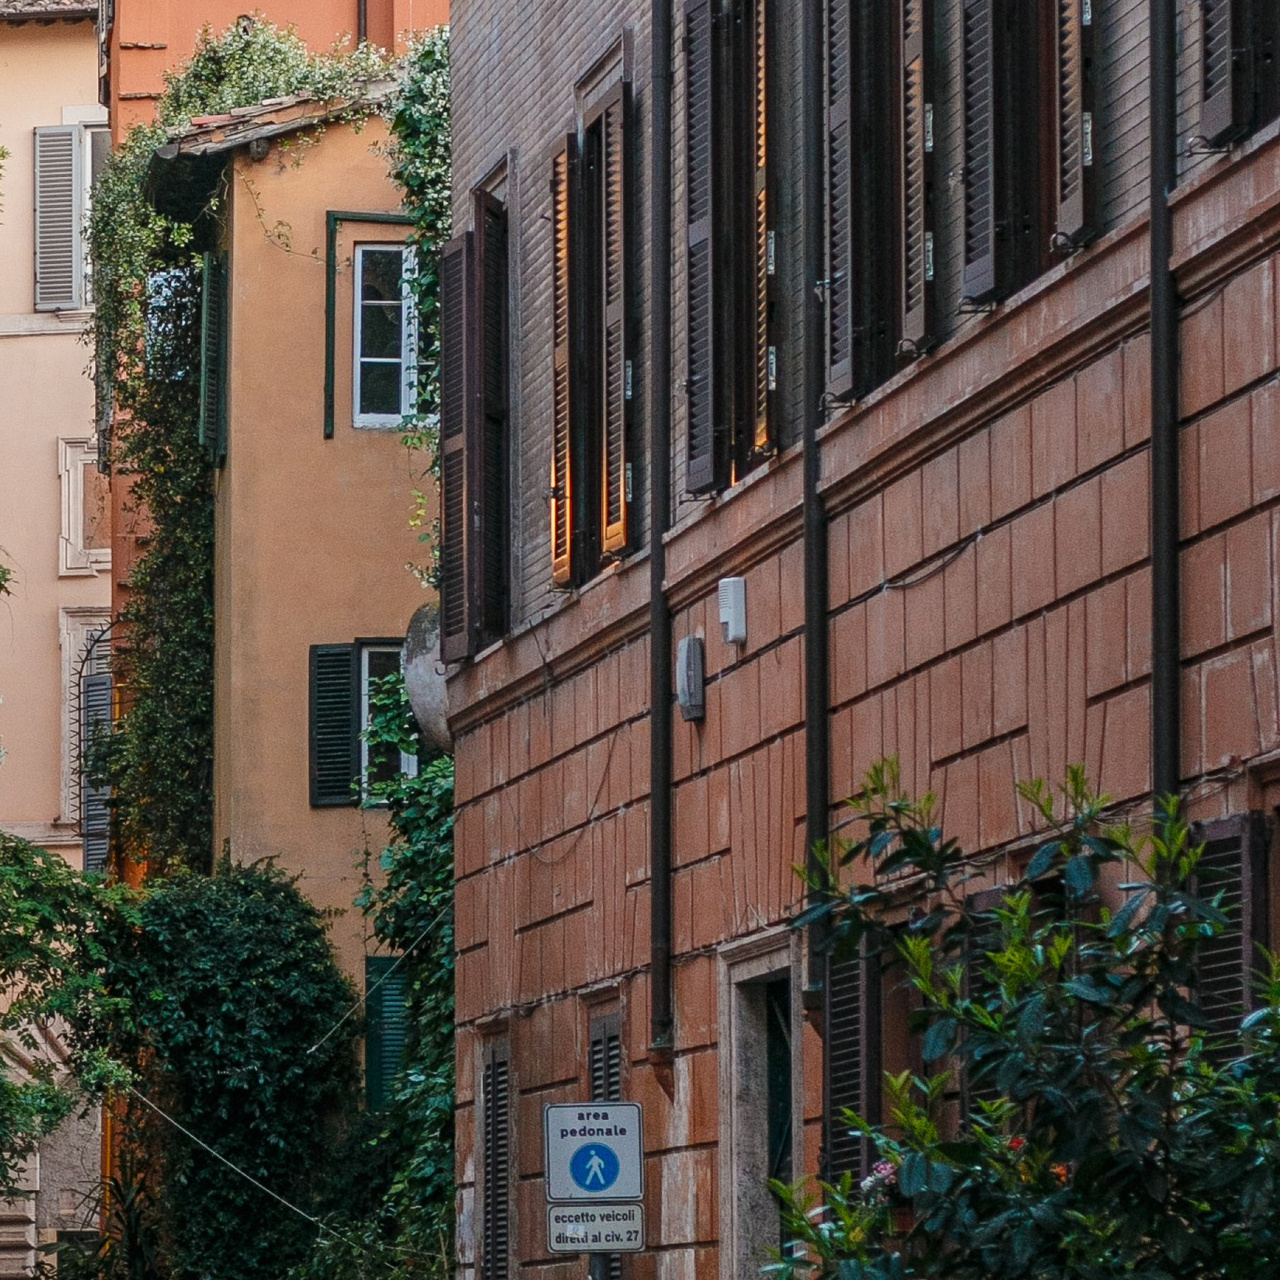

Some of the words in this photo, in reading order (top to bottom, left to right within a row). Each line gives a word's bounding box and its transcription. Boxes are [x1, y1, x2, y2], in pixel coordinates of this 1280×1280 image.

[577, 1111, 609, 1121] area
[560, 1125, 627, 1139] pedonale
[554, 1212, 596, 1224] eccetto
[599, 1209, 635, 1222] veicoli
[592, 1231, 602, 1243] al
[604, 1230, 624, 1243] civ.
[626, 1229, 639, 1242] 27
